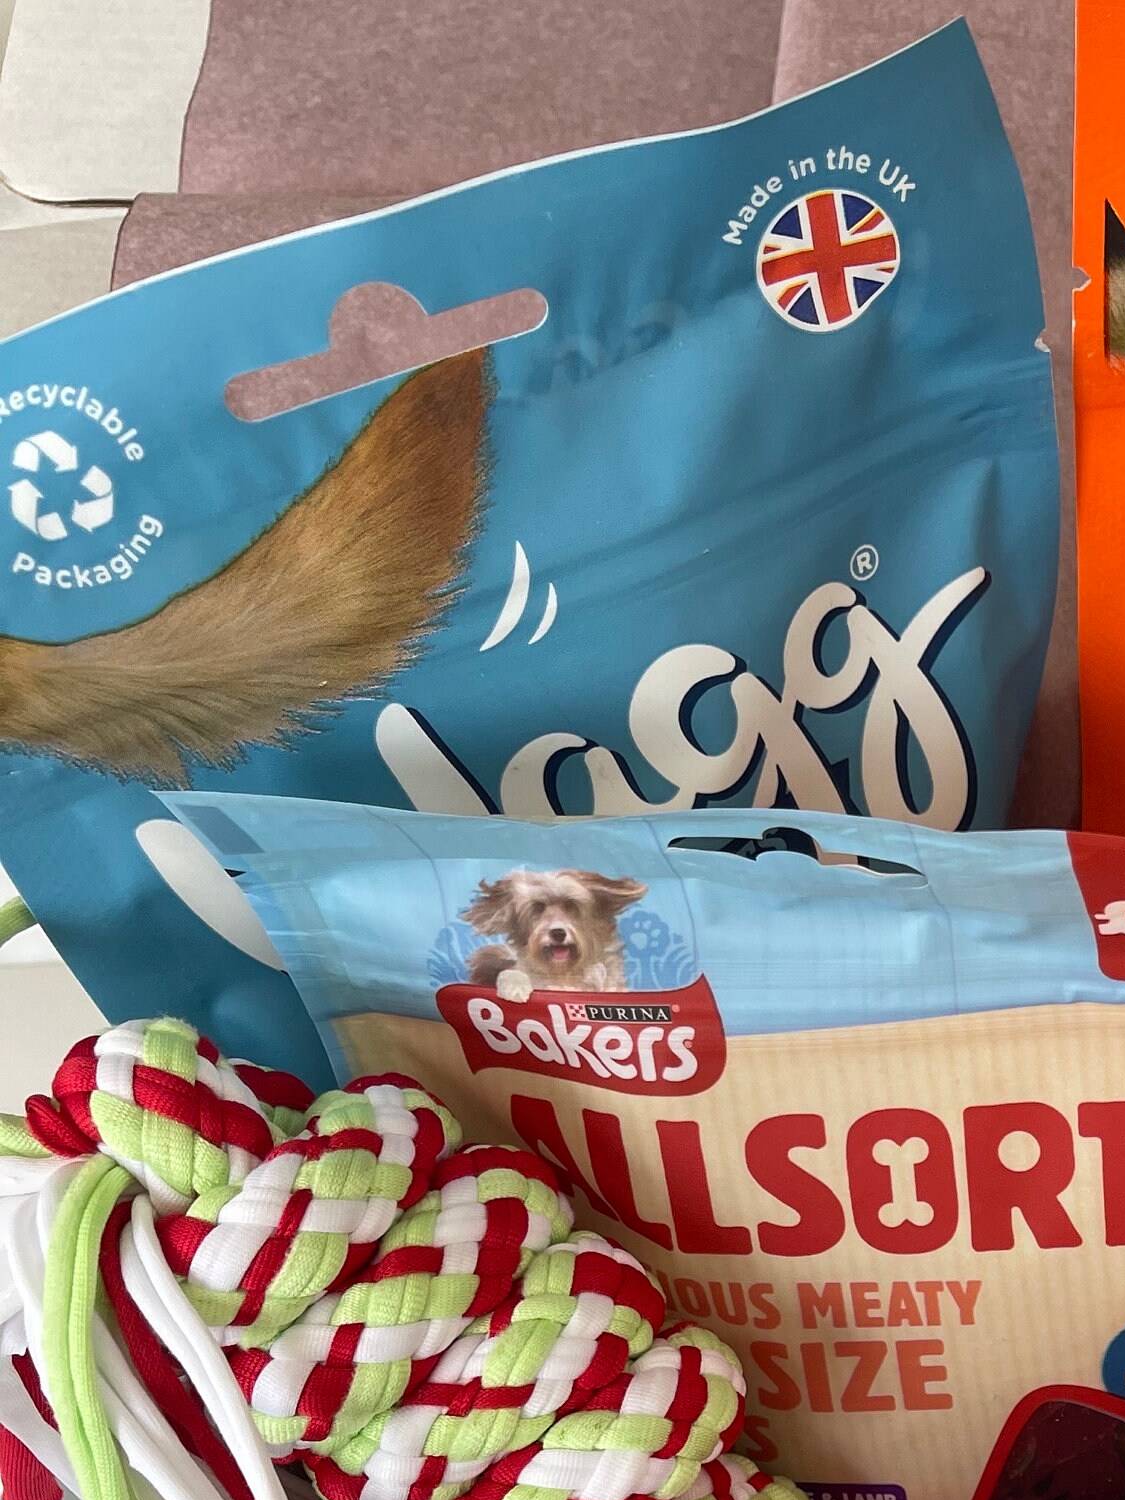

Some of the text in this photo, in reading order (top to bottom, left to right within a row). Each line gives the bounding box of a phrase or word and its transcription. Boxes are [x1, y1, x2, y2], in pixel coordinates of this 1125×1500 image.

[722, 146, 916, 245] Made in the UK
[12, 514, 163, 589] Packaging
[467, 998, 698, 1082] Bakers
[588, 1005, 669, 1022] PURINA
[797, 1280, 982, 1329] MEATY
[751, 1339, 953, 1413] SIZE
